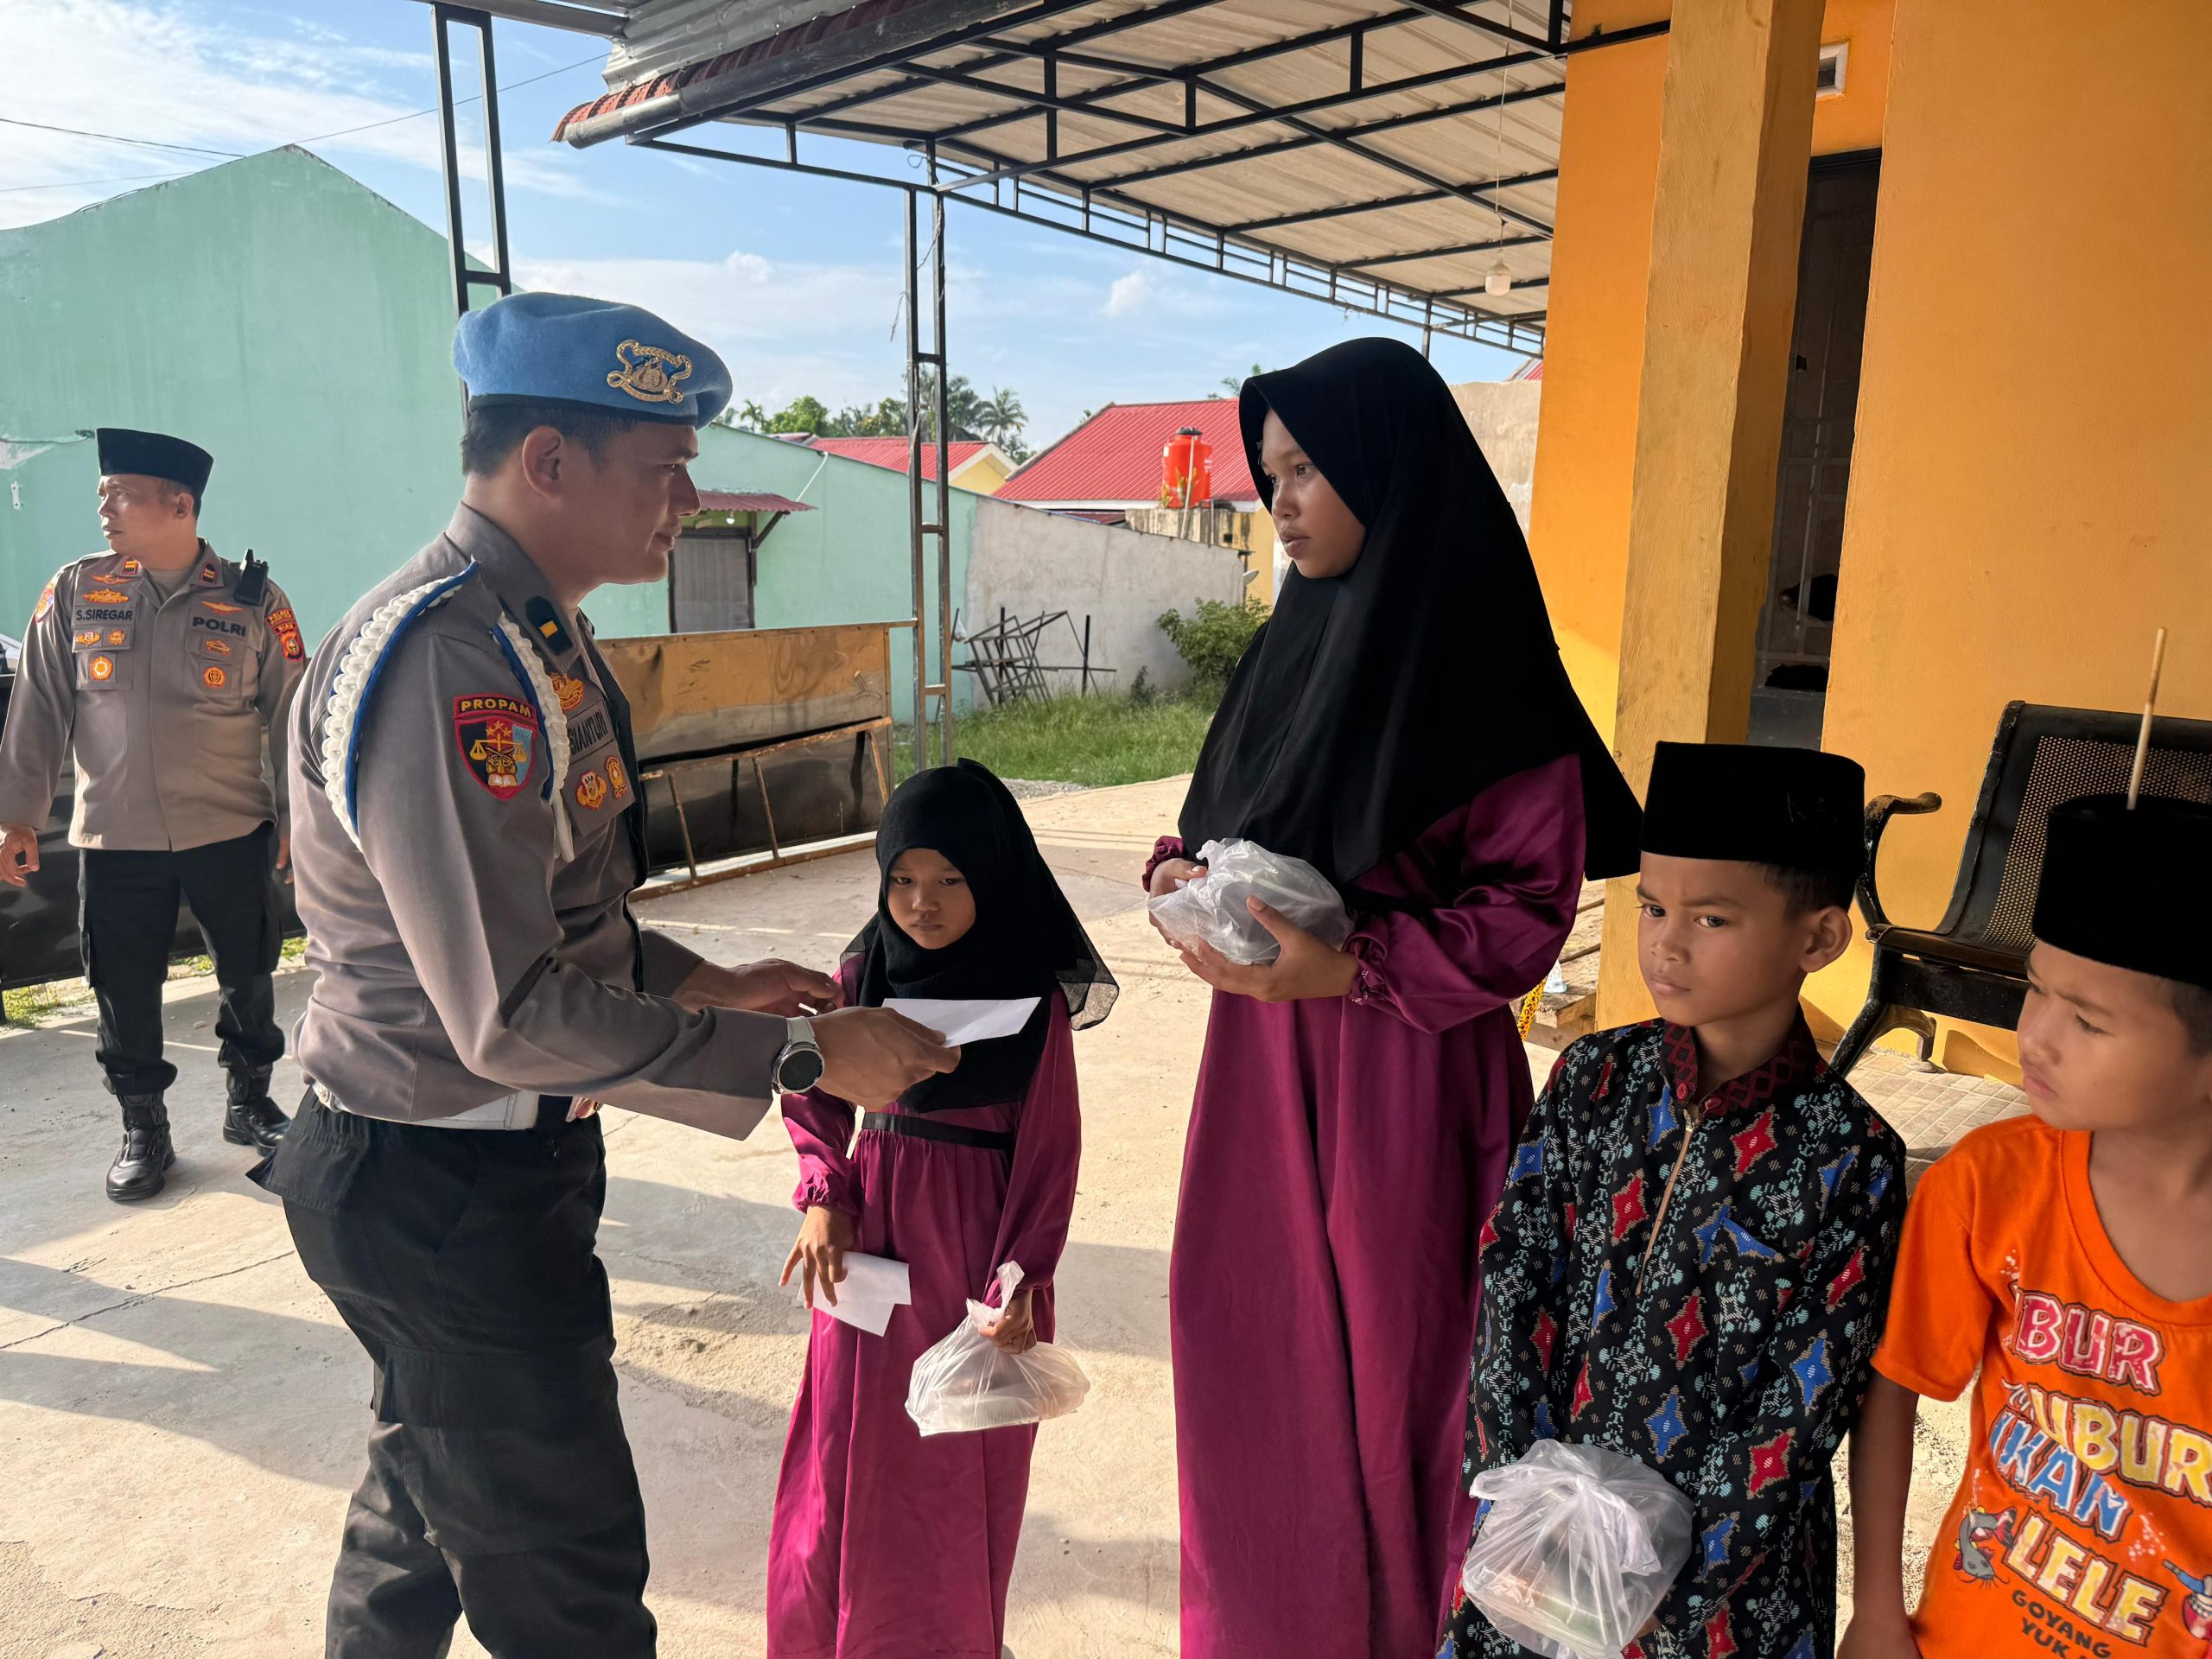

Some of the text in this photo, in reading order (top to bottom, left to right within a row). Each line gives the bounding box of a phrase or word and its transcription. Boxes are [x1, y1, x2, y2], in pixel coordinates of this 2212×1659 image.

[75, 608, 133, 621] S.SIREGAR
[192, 616, 246, 637] POLRI
[461, 698, 533, 720] PROPAM
[1989, 1408, 2130, 1538] IKAN
[2006, 1514, 2163, 1642] LELE
[2012, 1589, 2112, 1658] GOYANG
[2022, 1617, 2071, 1659] YUK
